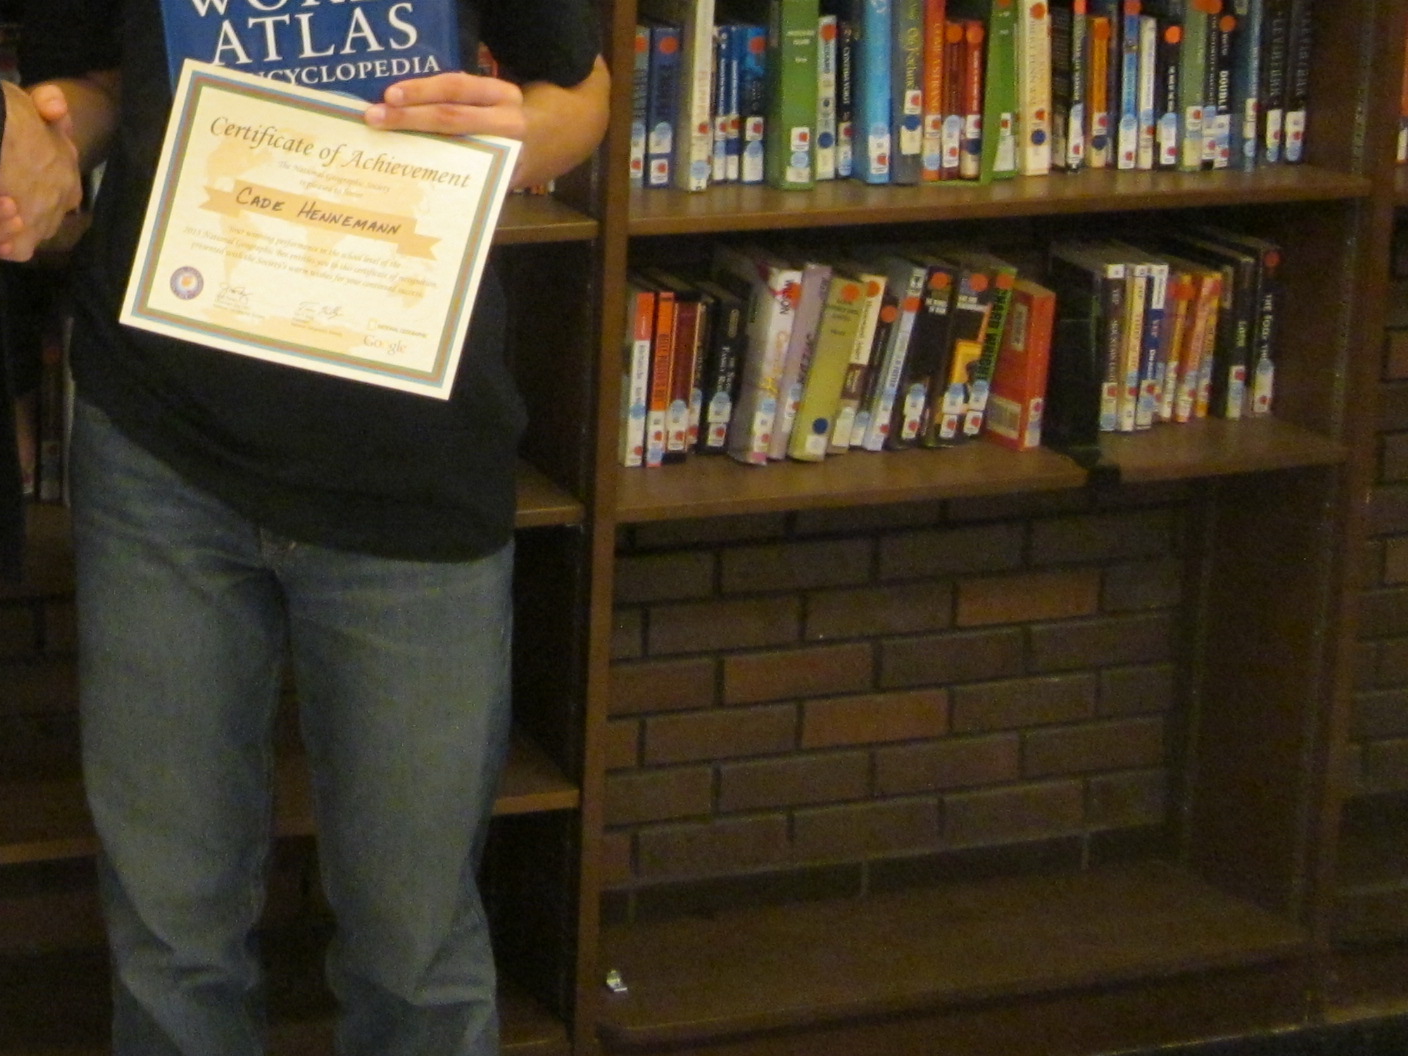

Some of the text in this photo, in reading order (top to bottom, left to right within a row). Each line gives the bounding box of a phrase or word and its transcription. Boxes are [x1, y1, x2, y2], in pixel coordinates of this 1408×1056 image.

[212, 2, 418, 66] ATLAS
[930, 69, 944, 112] STRANG
[1217, 69, 1230, 112] DOUBLE
[210, 116, 472, 189] Certificate of Achievement
[235, 186, 401, 235] CADE HENNEMANN
